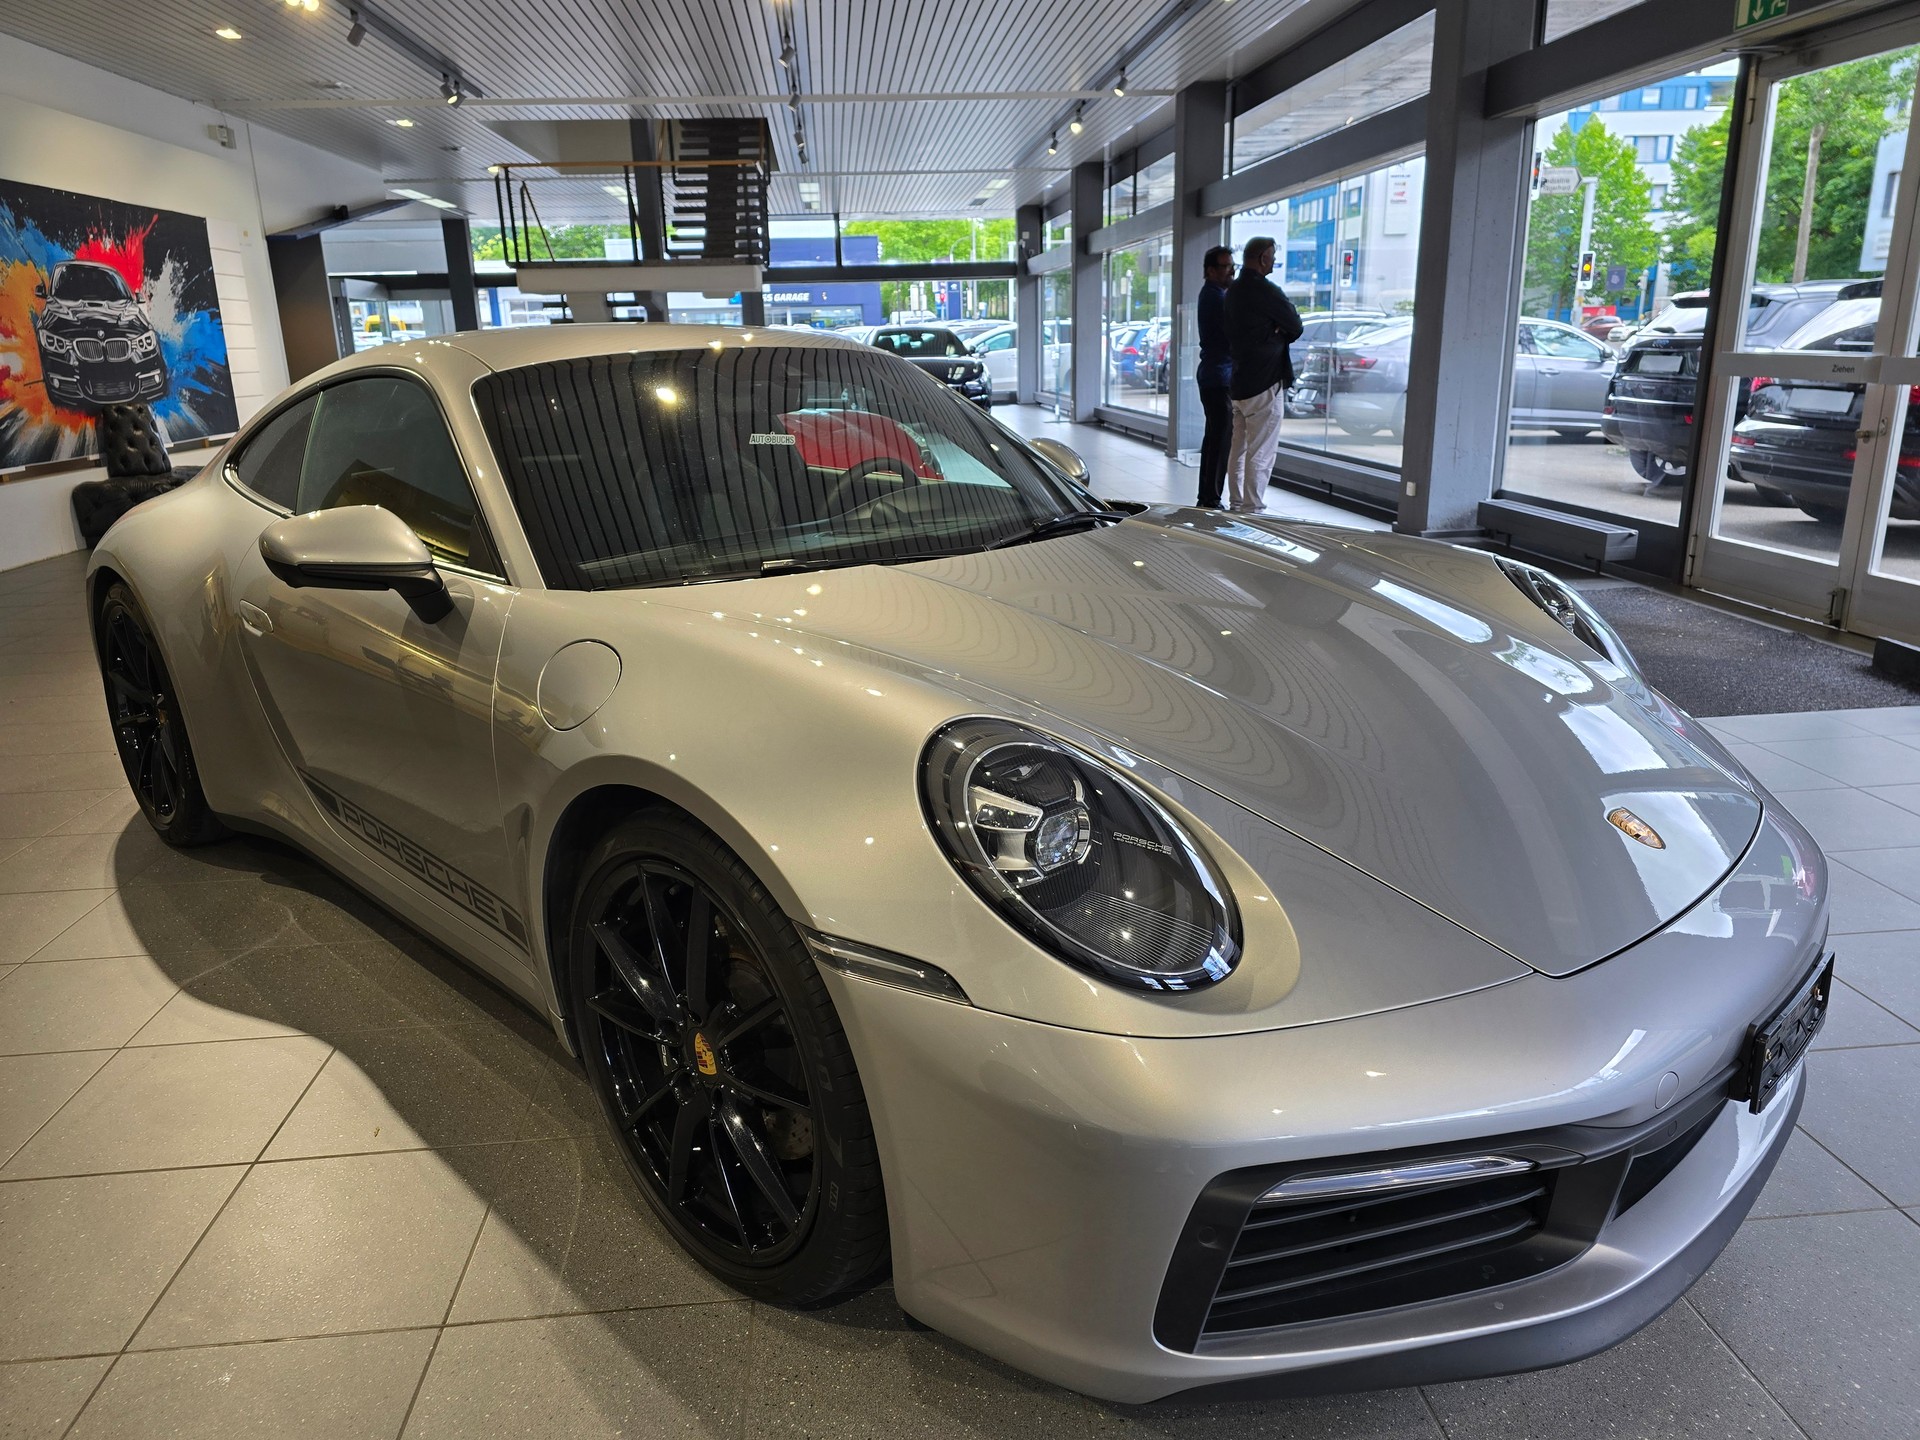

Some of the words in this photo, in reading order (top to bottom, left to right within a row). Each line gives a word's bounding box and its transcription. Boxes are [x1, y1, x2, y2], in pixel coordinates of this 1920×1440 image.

[773, 292, 810, 302] GARAGE
[1831, 364, 1855, 373] Ziehen
[1113, 831, 1173, 852] PORSCHE
[1147, 846, 1172, 855] SYSTEM
[339, 800, 502, 924] PORSCHE
